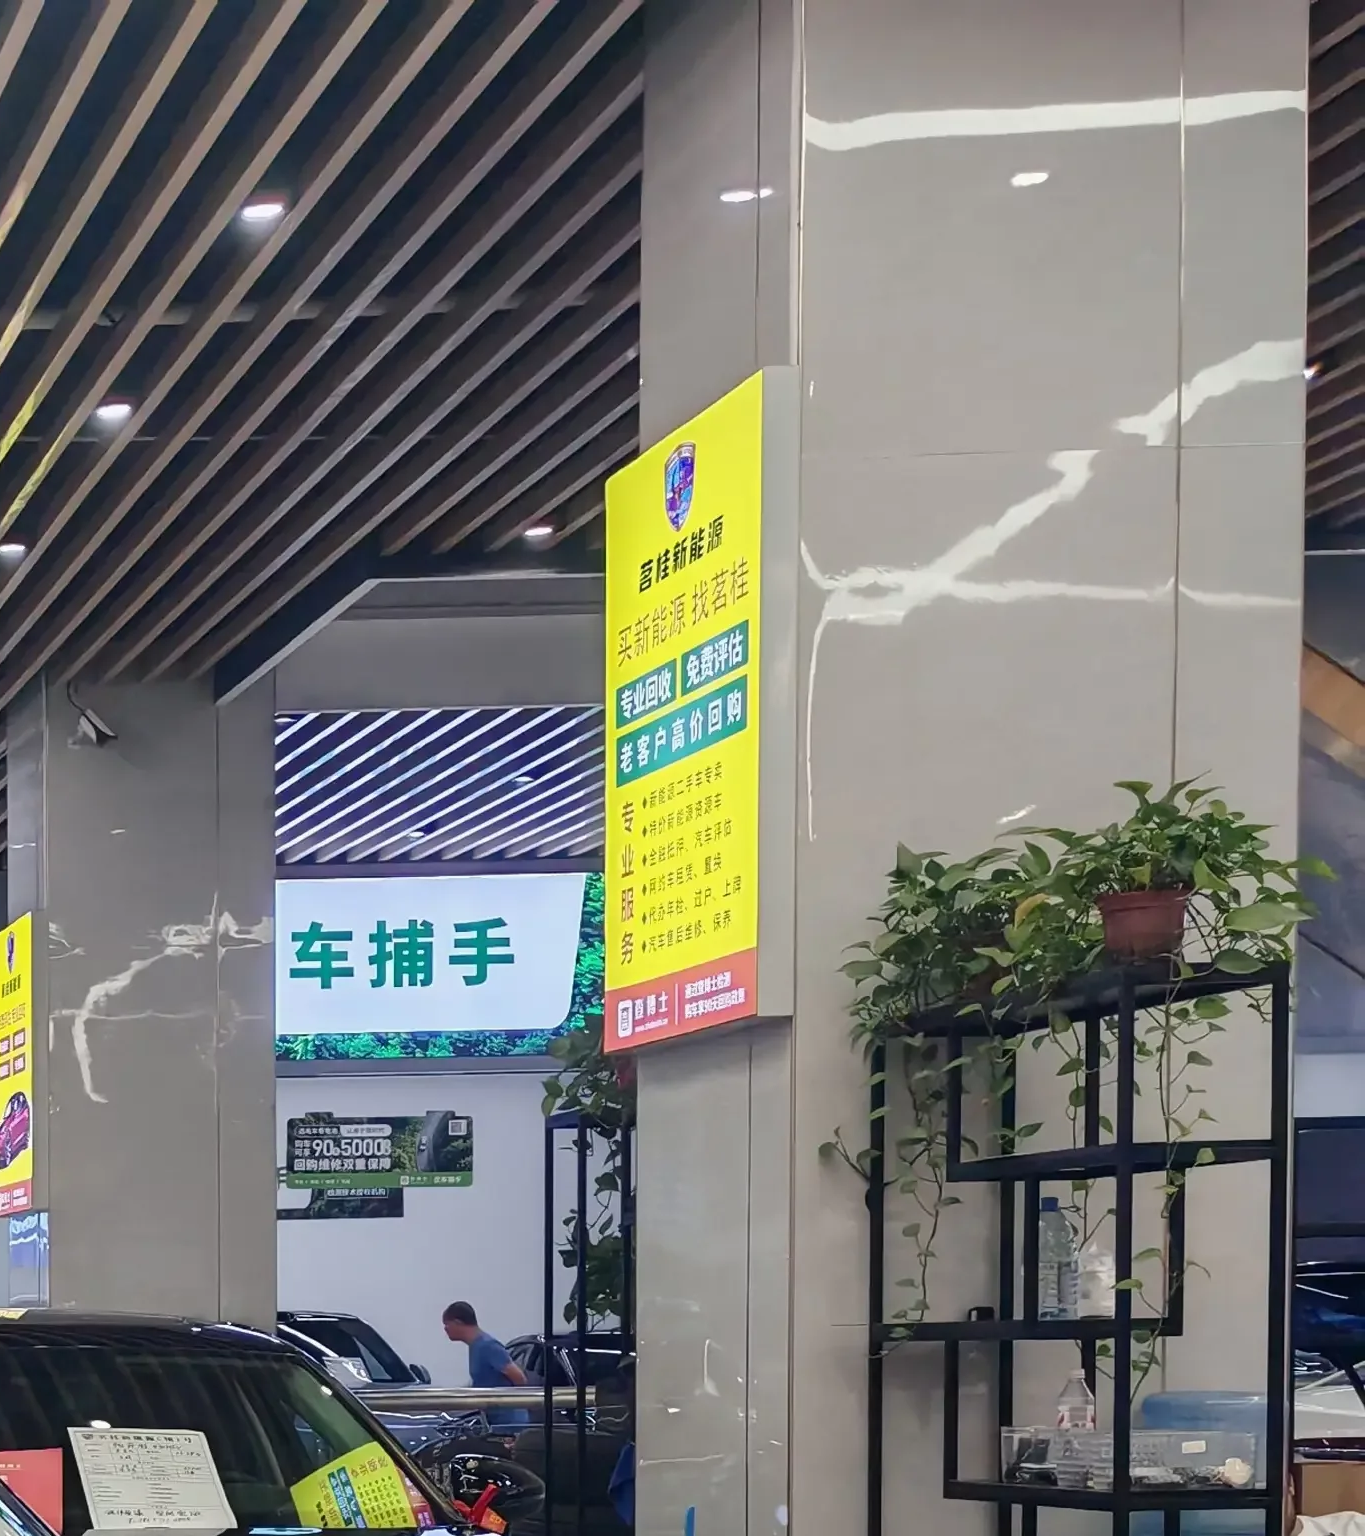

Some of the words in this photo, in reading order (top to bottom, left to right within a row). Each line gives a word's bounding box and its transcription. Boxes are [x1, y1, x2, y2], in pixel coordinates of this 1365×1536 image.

[639, 514, 724, 594] 茗桂新能源
[618, 593, 686, 667] 买新能源
[692, 556, 749, 626] 找茗桂
[620, 667, 672, 719] 专业回收
[686, 629, 744, 688] 免费评估
[620, 688, 742, 774] 老客户高价回购
[621, 801, 635, 966] 专业服务
[289, 917, 515, 990] 车捕手
